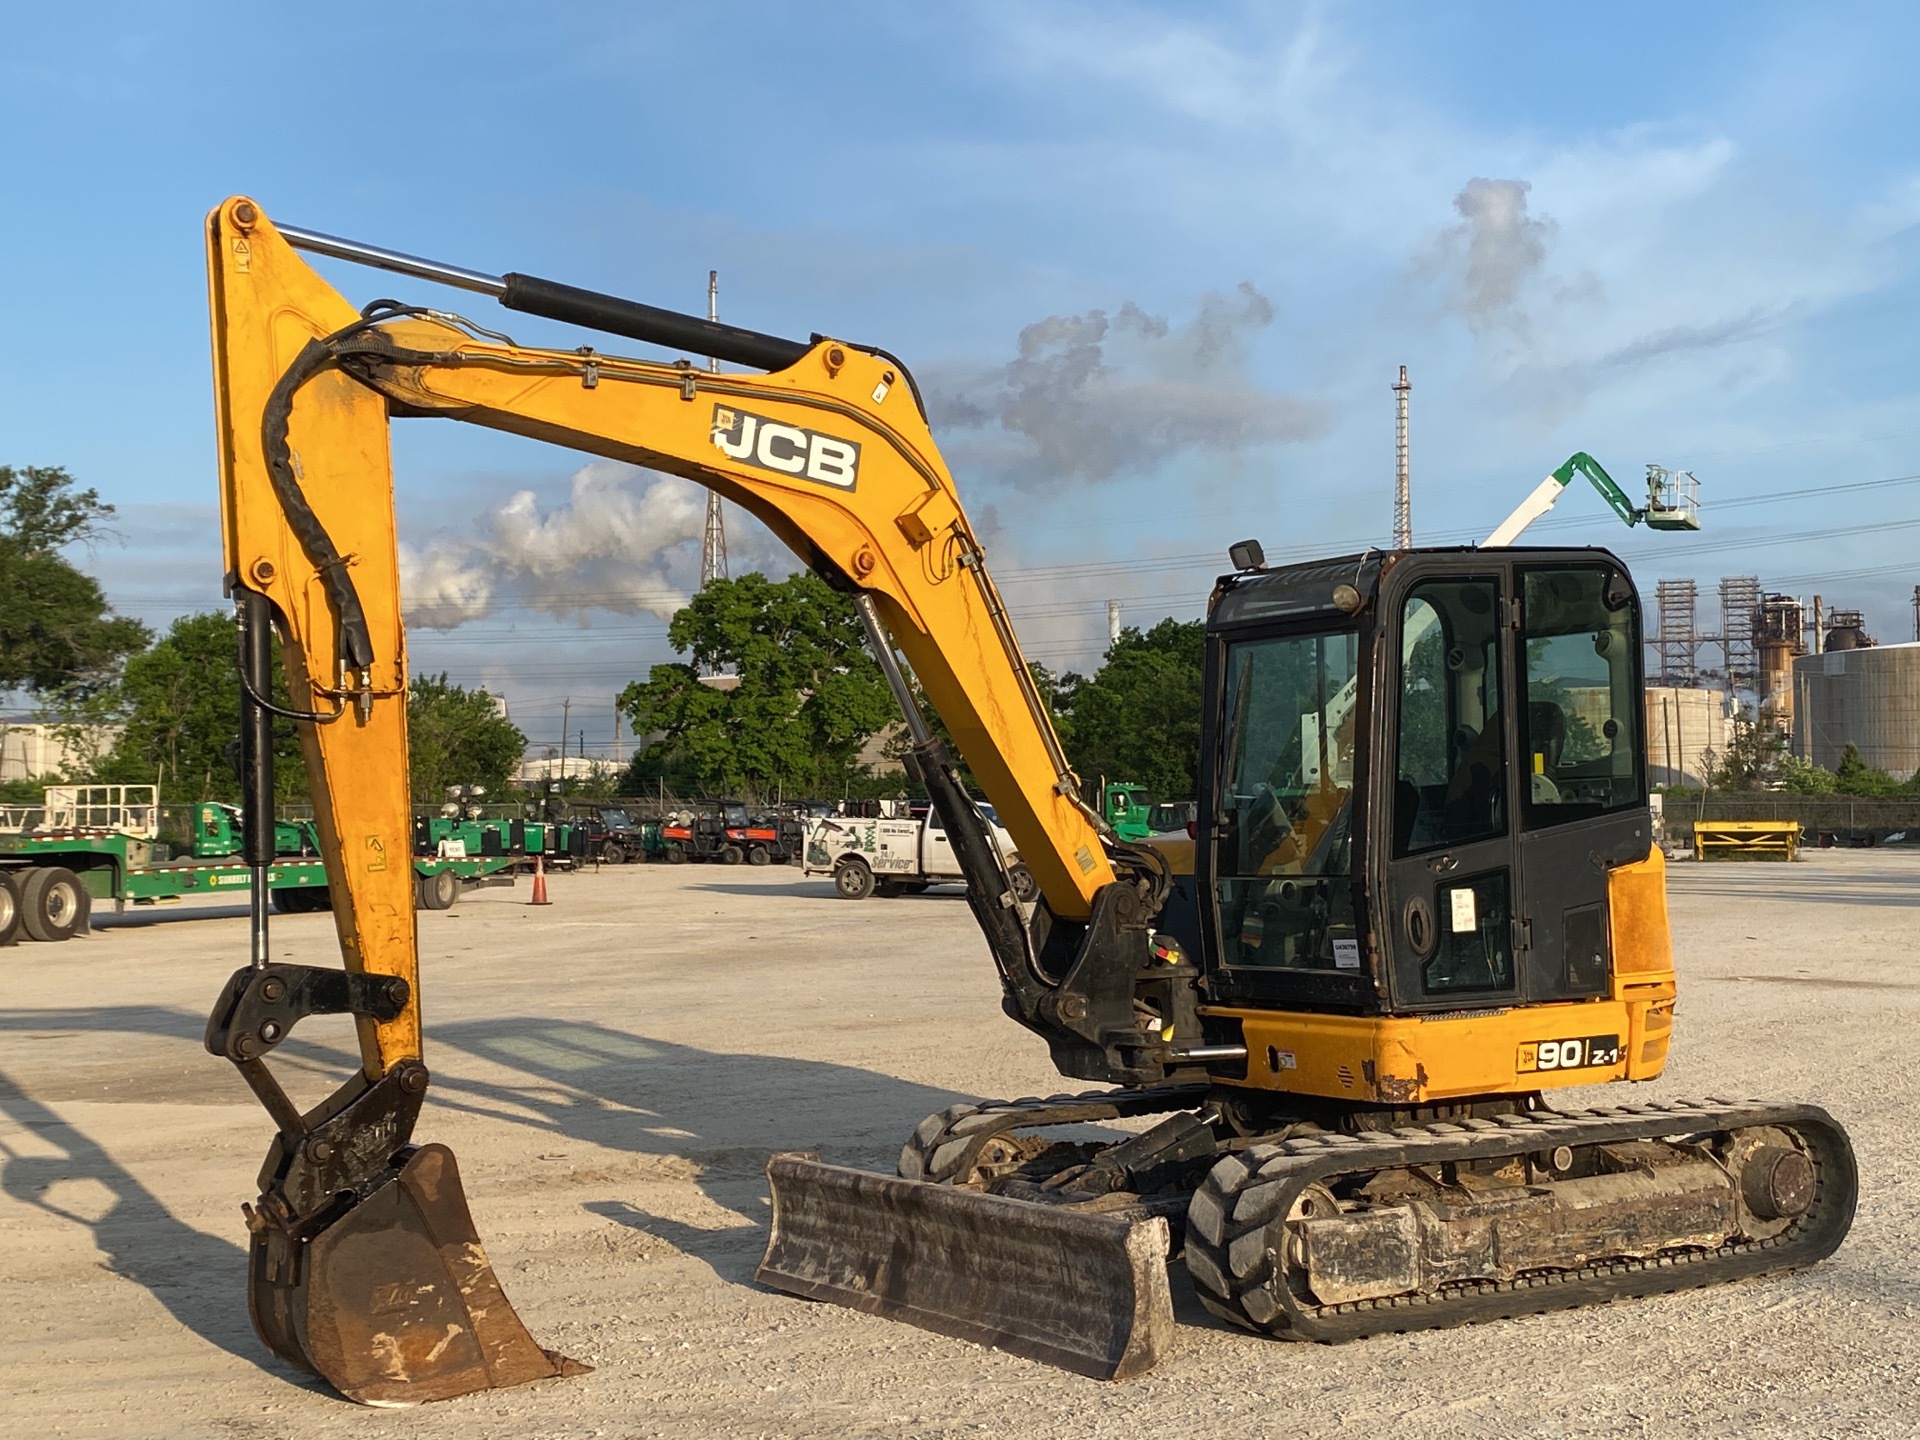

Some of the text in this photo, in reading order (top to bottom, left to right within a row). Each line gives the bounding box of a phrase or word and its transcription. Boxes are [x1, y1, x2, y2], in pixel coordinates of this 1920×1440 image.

[713, 415, 856, 487] JCB
[871, 856, 911, 870] Service
[880, 851, 895, 859] 24/7
[1538, 1040, 1582, 1070] 90
